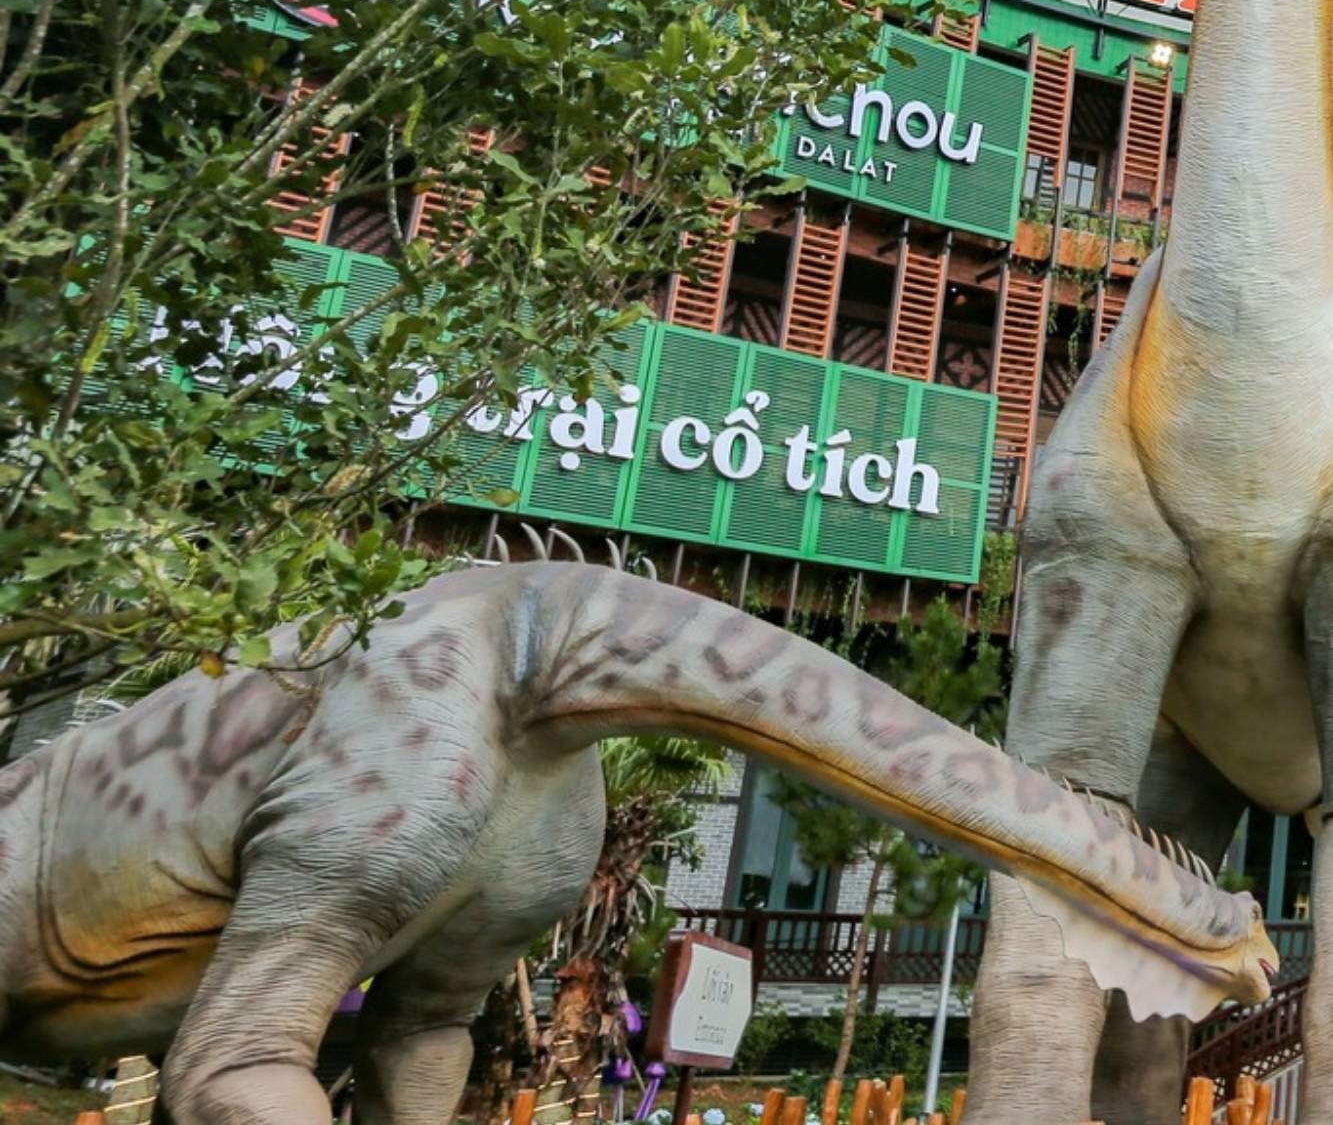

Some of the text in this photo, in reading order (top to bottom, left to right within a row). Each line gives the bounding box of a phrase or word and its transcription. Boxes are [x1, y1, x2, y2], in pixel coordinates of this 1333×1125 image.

[797, 135, 897, 183] DALAT
[660, 389, 770, 480] cổ
[784, 424, 940, 515] tích
